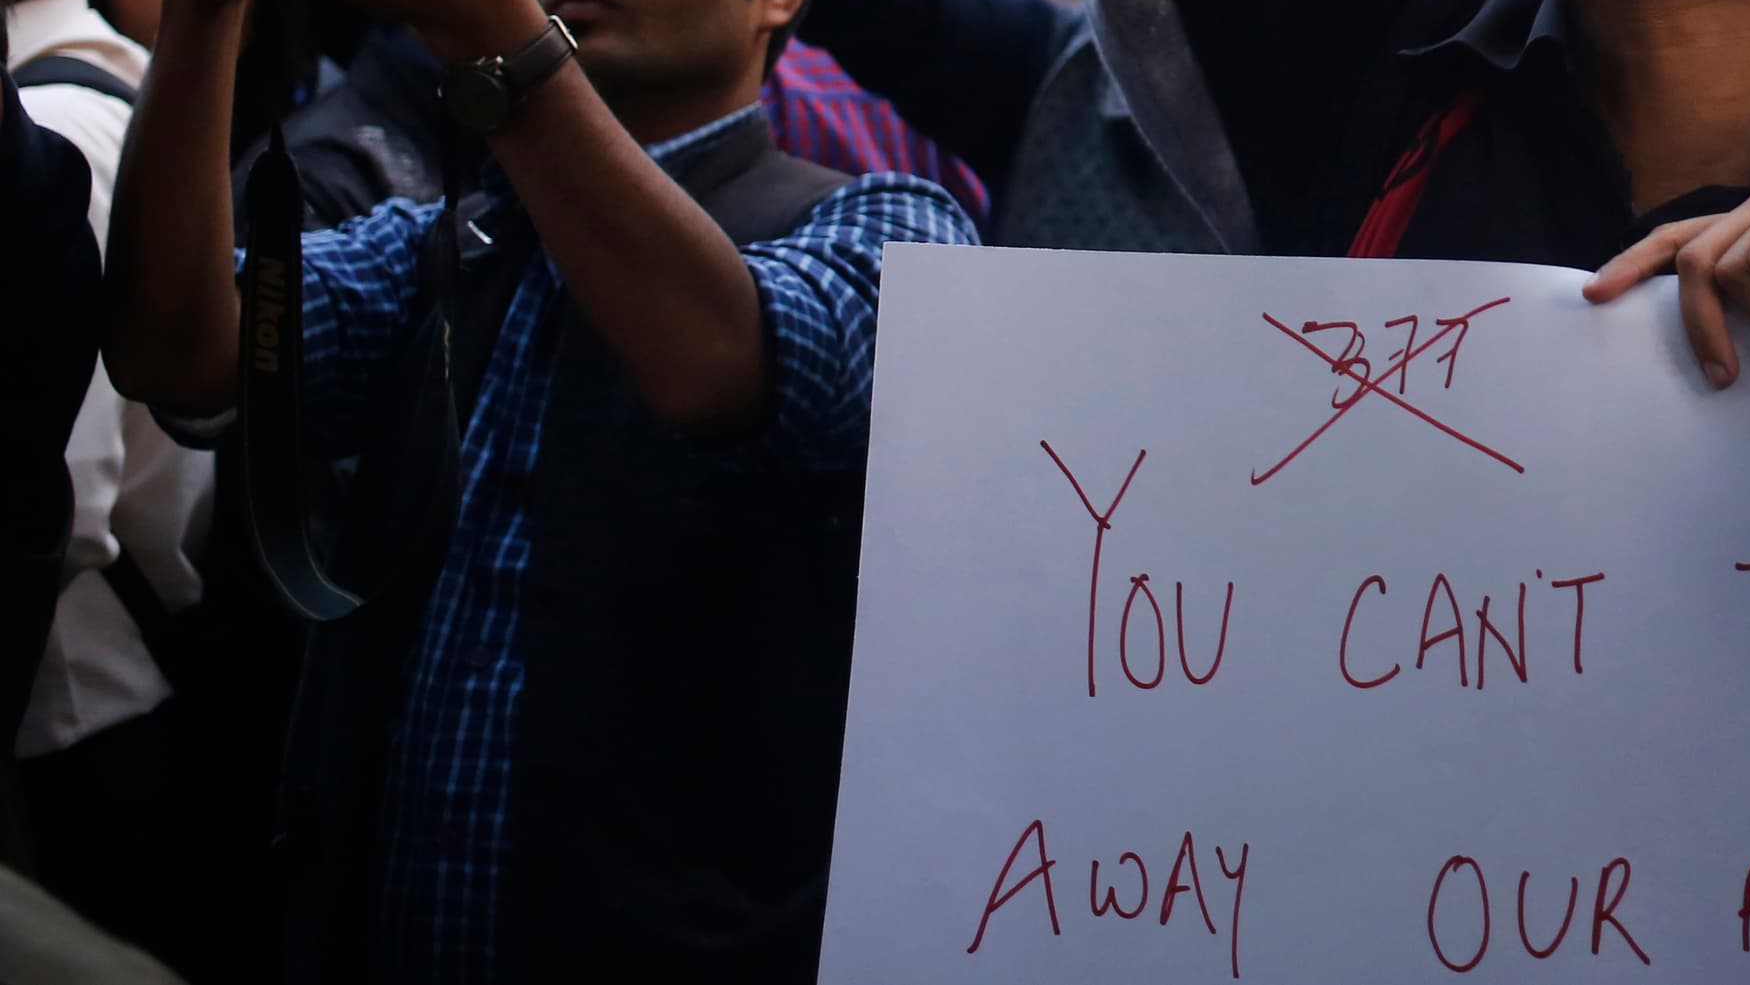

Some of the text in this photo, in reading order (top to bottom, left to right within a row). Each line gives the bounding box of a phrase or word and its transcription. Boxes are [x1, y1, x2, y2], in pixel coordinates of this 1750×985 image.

[255, 255, 288, 373] Nikon
[1302, 314, 1469, 409] 377
[1040, 439, 1234, 697] YOU
[1340, 568, 1605, 690] CAN'T
[966, 819, 1249, 979] AWAY
[1427, 854, 1650, 973] OUR
